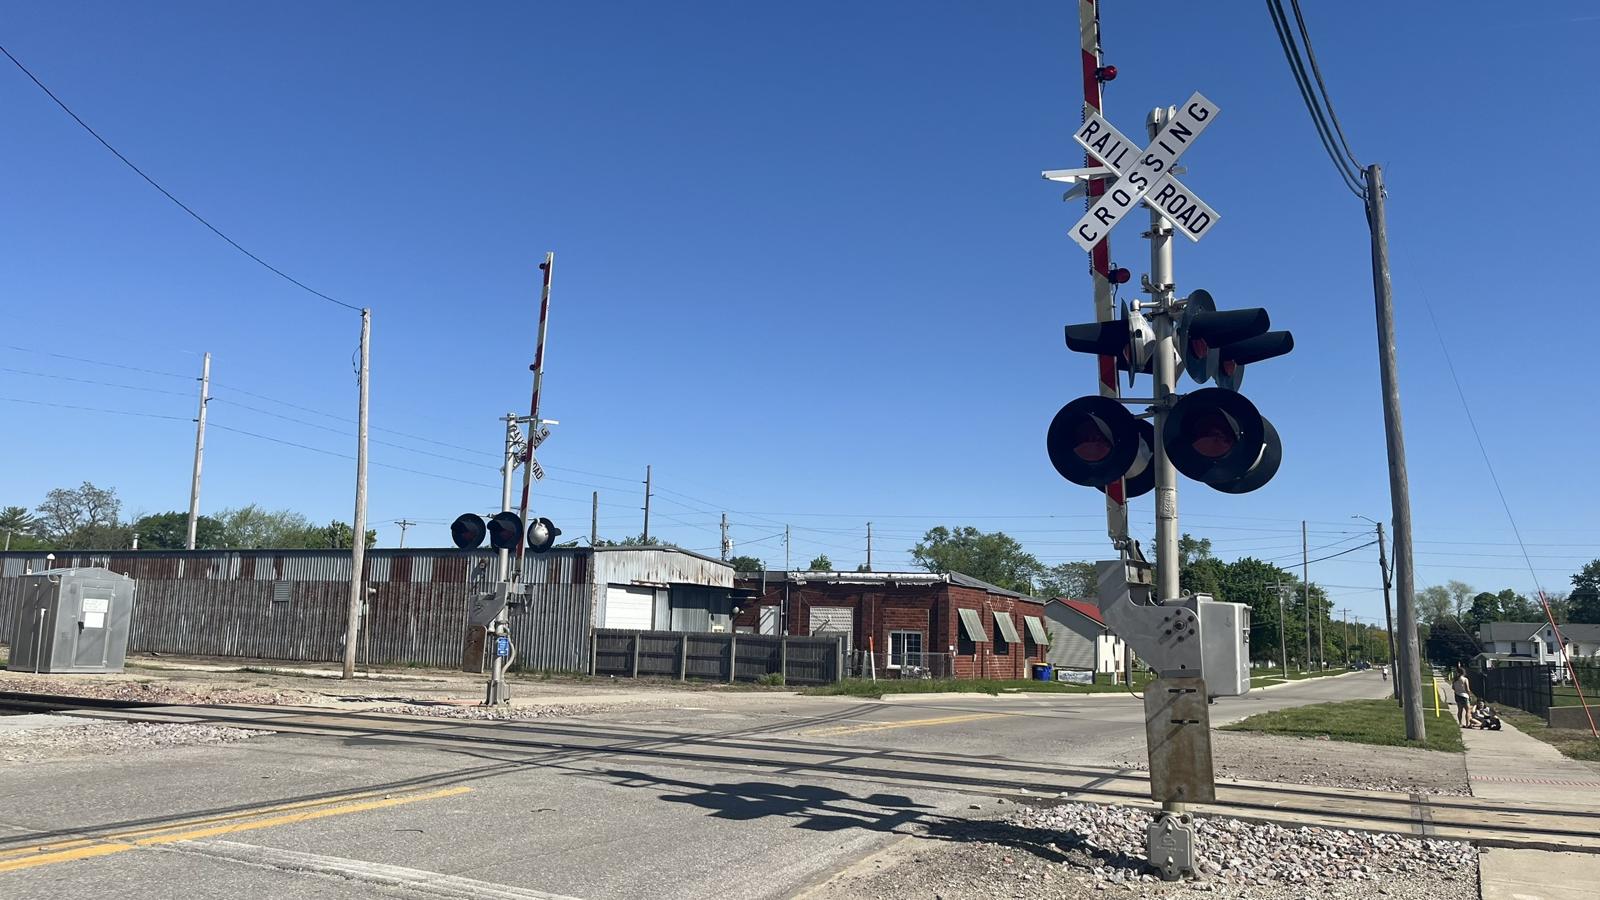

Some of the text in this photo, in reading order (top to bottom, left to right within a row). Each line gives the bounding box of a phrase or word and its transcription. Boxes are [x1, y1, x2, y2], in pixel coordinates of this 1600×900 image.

[1078, 102, 1210, 242] CROSSING
[1080, 119, 1211, 235] RAIL ROAD
